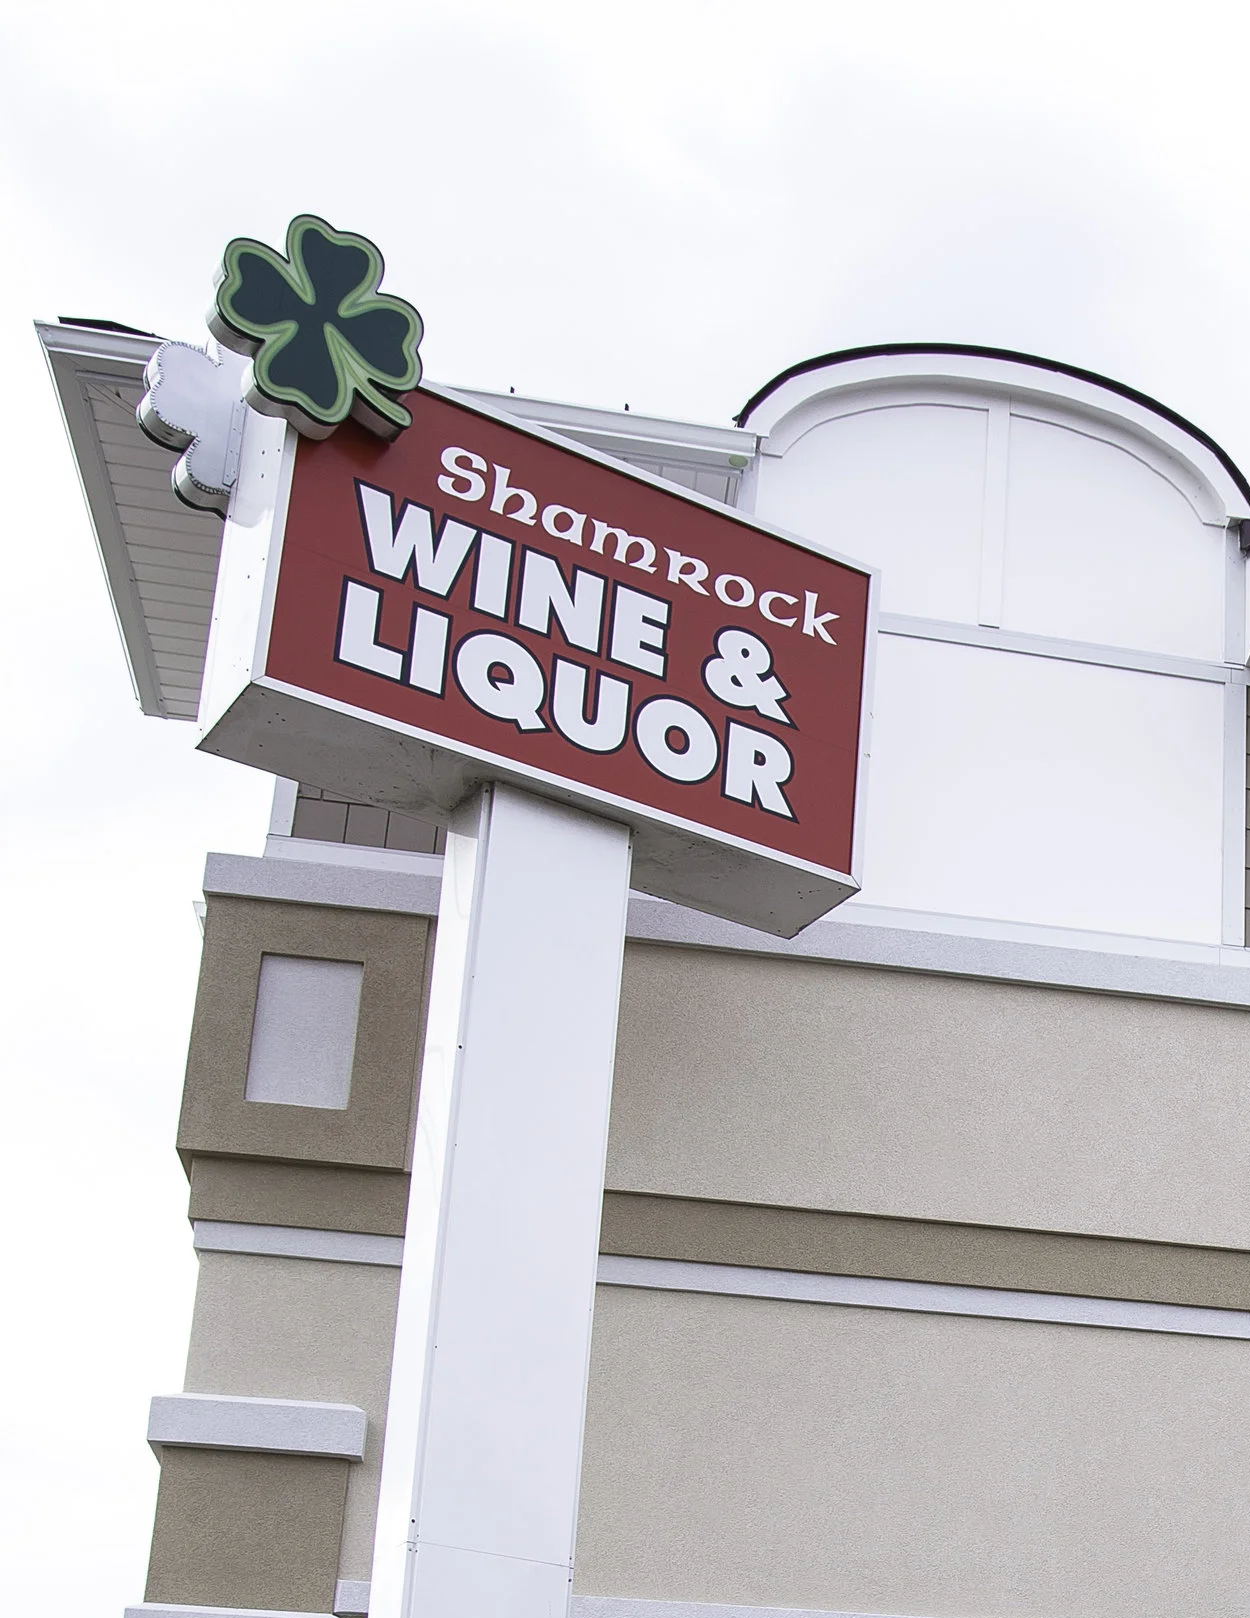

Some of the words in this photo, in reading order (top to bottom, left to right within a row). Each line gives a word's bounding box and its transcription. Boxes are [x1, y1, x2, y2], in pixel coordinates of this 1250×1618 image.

[335, 577, 798, 822] LIQUOR
[355, 478, 672, 680] WINE
[704, 626, 798, 730] &
